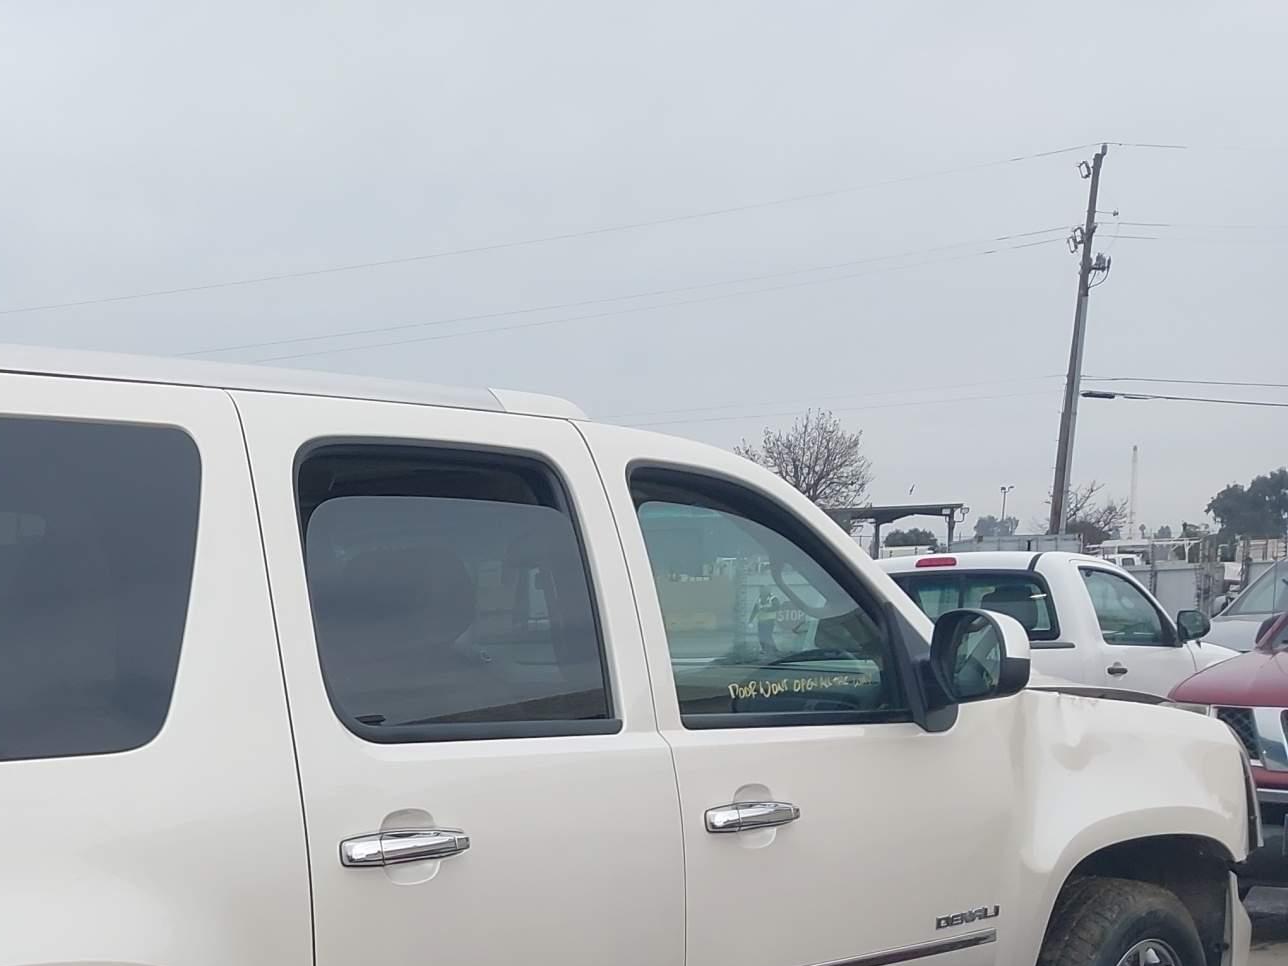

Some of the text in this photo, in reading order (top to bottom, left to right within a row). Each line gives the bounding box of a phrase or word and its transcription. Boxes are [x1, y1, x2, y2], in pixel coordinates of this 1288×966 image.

[776, 609, 806, 622] STOP
[727, 680, 758, 699] DOOR
[759, 678, 789, 698] WONT
[935, 904, 1000, 930] DENALI
